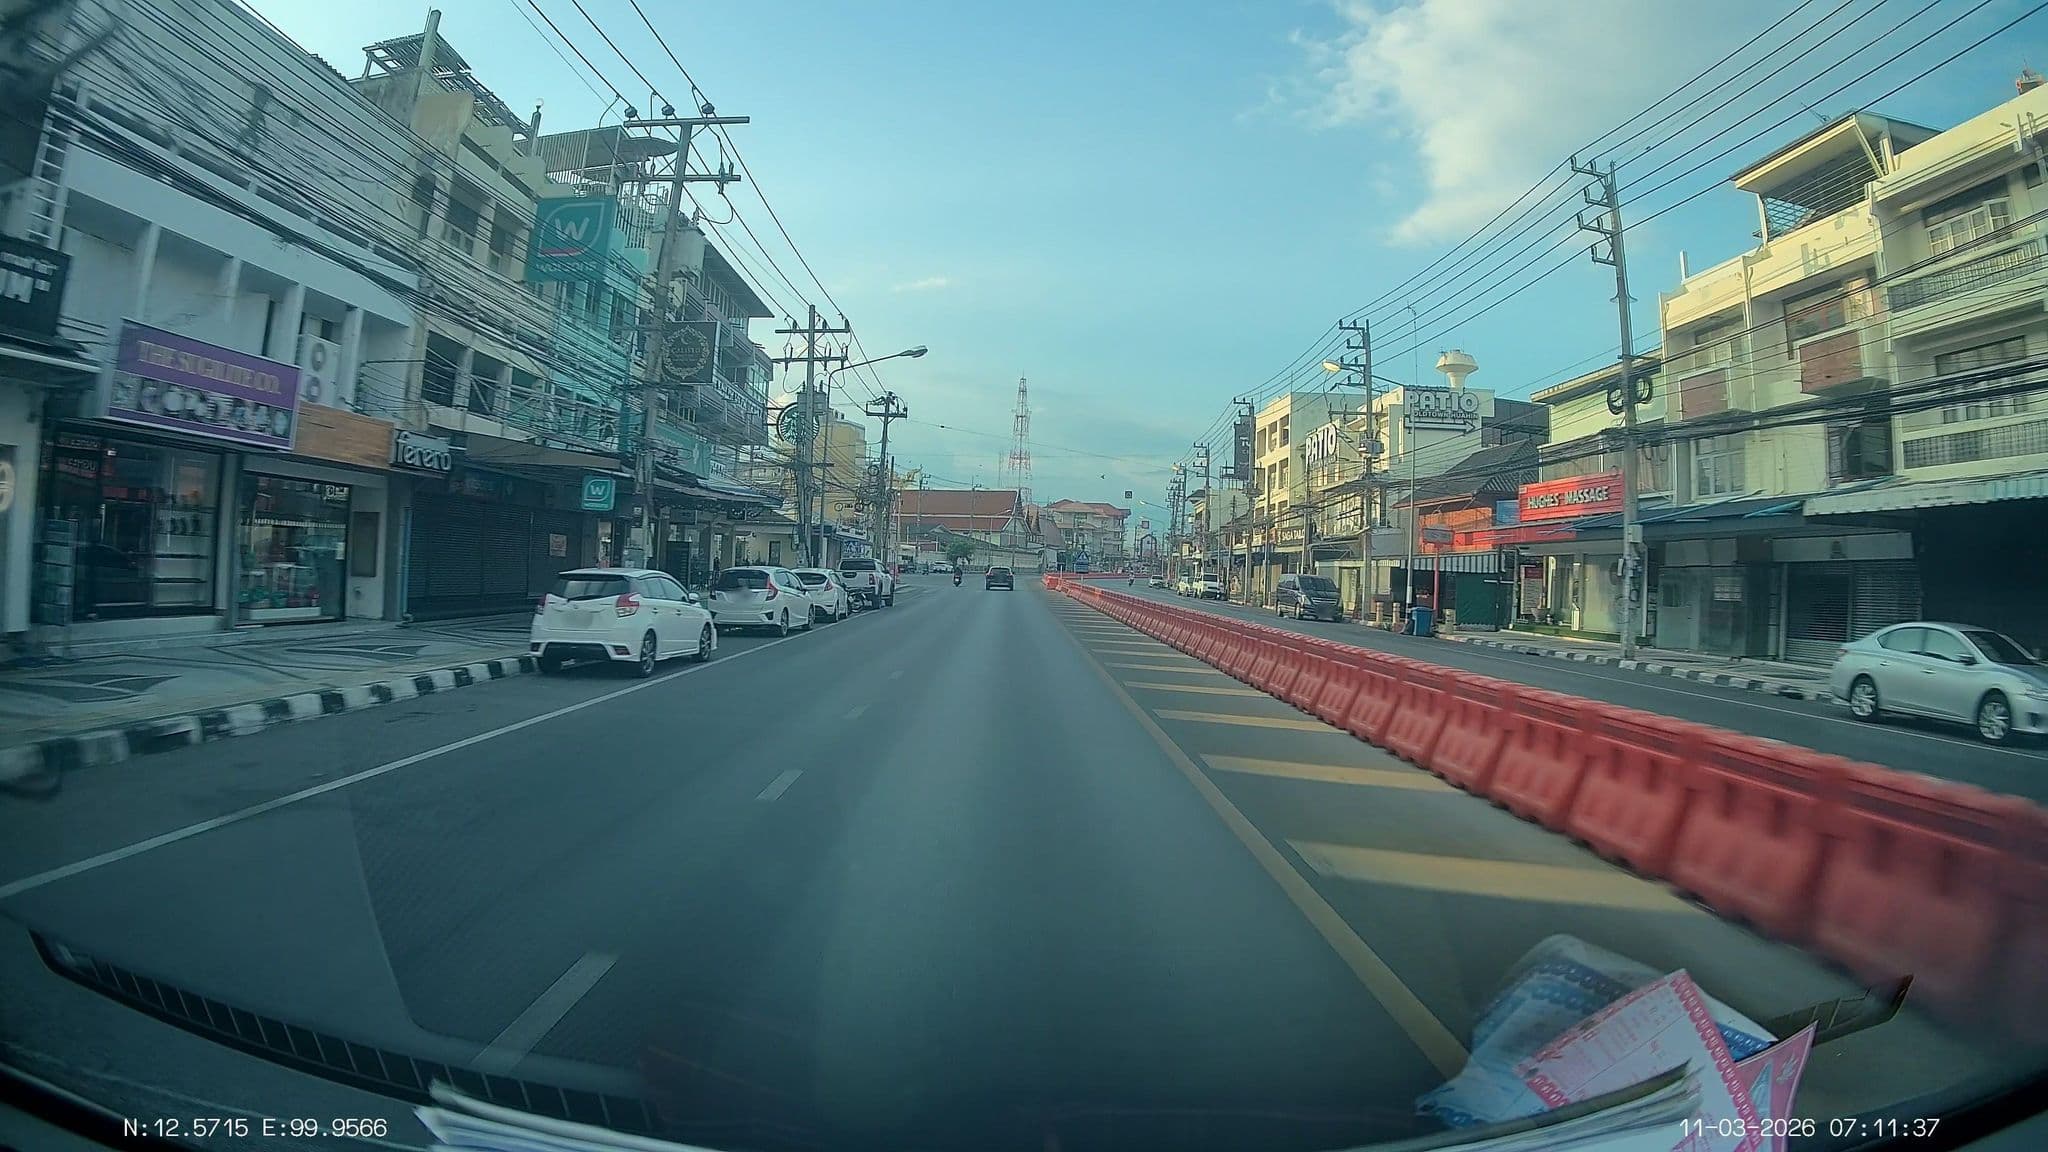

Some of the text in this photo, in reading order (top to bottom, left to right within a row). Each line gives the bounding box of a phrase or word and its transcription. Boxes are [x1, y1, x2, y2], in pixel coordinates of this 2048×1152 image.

[555, 216, 590, 242] W
[1404, 390, 1479, 415] PATIO
[397, 431, 452, 471] ferero
[1305, 422, 1337, 468] PATIO
[1527, 485, 1609, 509] HUGHES MASSAGE
